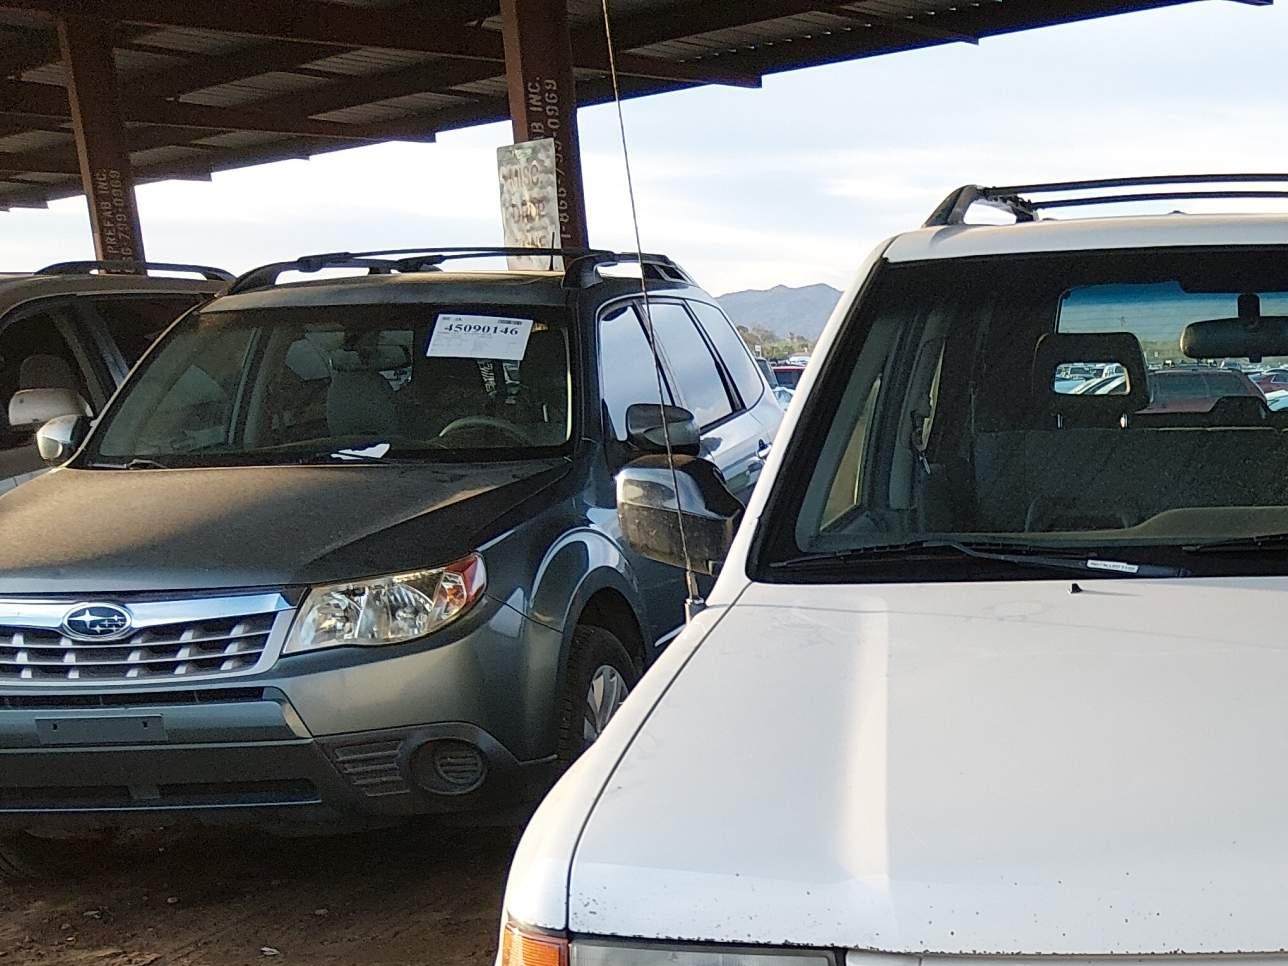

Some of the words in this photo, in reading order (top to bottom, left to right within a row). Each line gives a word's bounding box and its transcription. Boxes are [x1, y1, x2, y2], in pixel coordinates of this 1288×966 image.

[527, 76, 543, 113] INC.
[100, 202, 119, 254] PREFAB
[444, 322, 519, 336] 45090146
